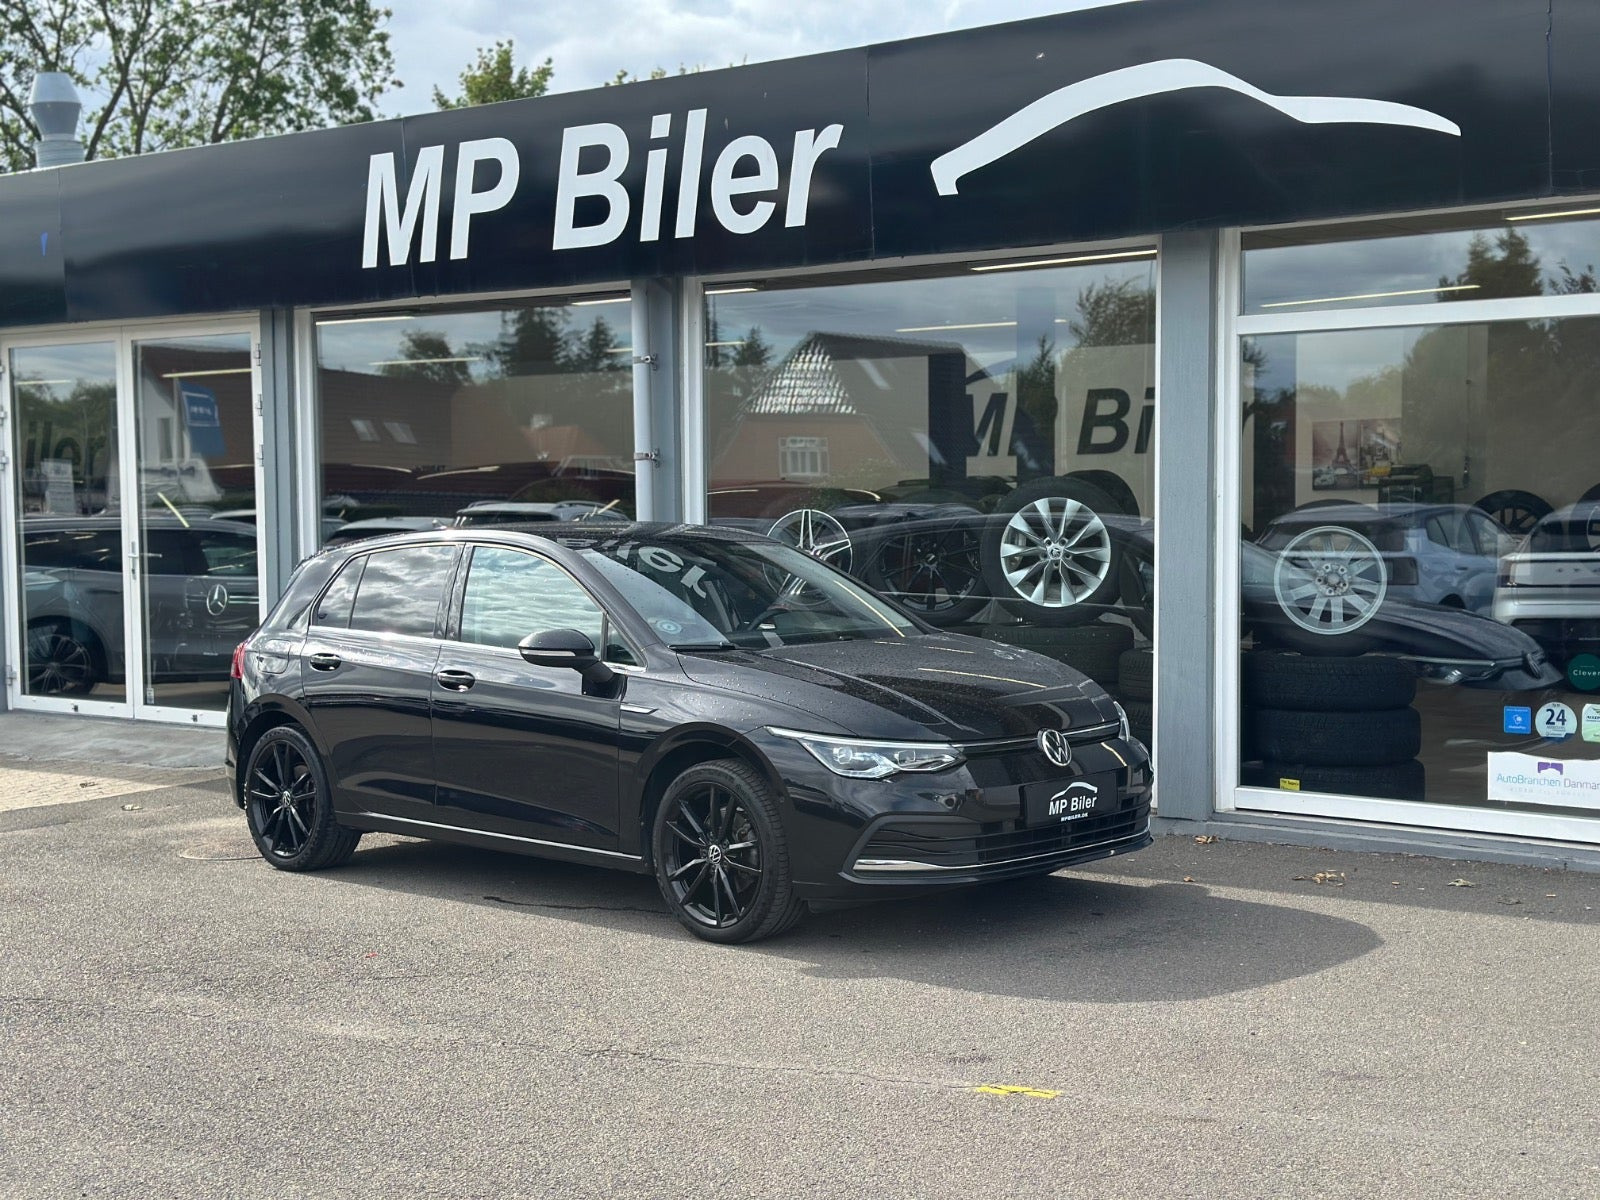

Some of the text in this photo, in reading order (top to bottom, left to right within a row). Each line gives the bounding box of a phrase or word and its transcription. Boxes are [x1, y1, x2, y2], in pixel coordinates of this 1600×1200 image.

[361, 108, 843, 269] MP Biler
[1545, 708, 1567, 726] 24
[1496, 773, 1600, 790] AutoBranchen Danmar
[1048, 795, 1098, 816] MP Biler
